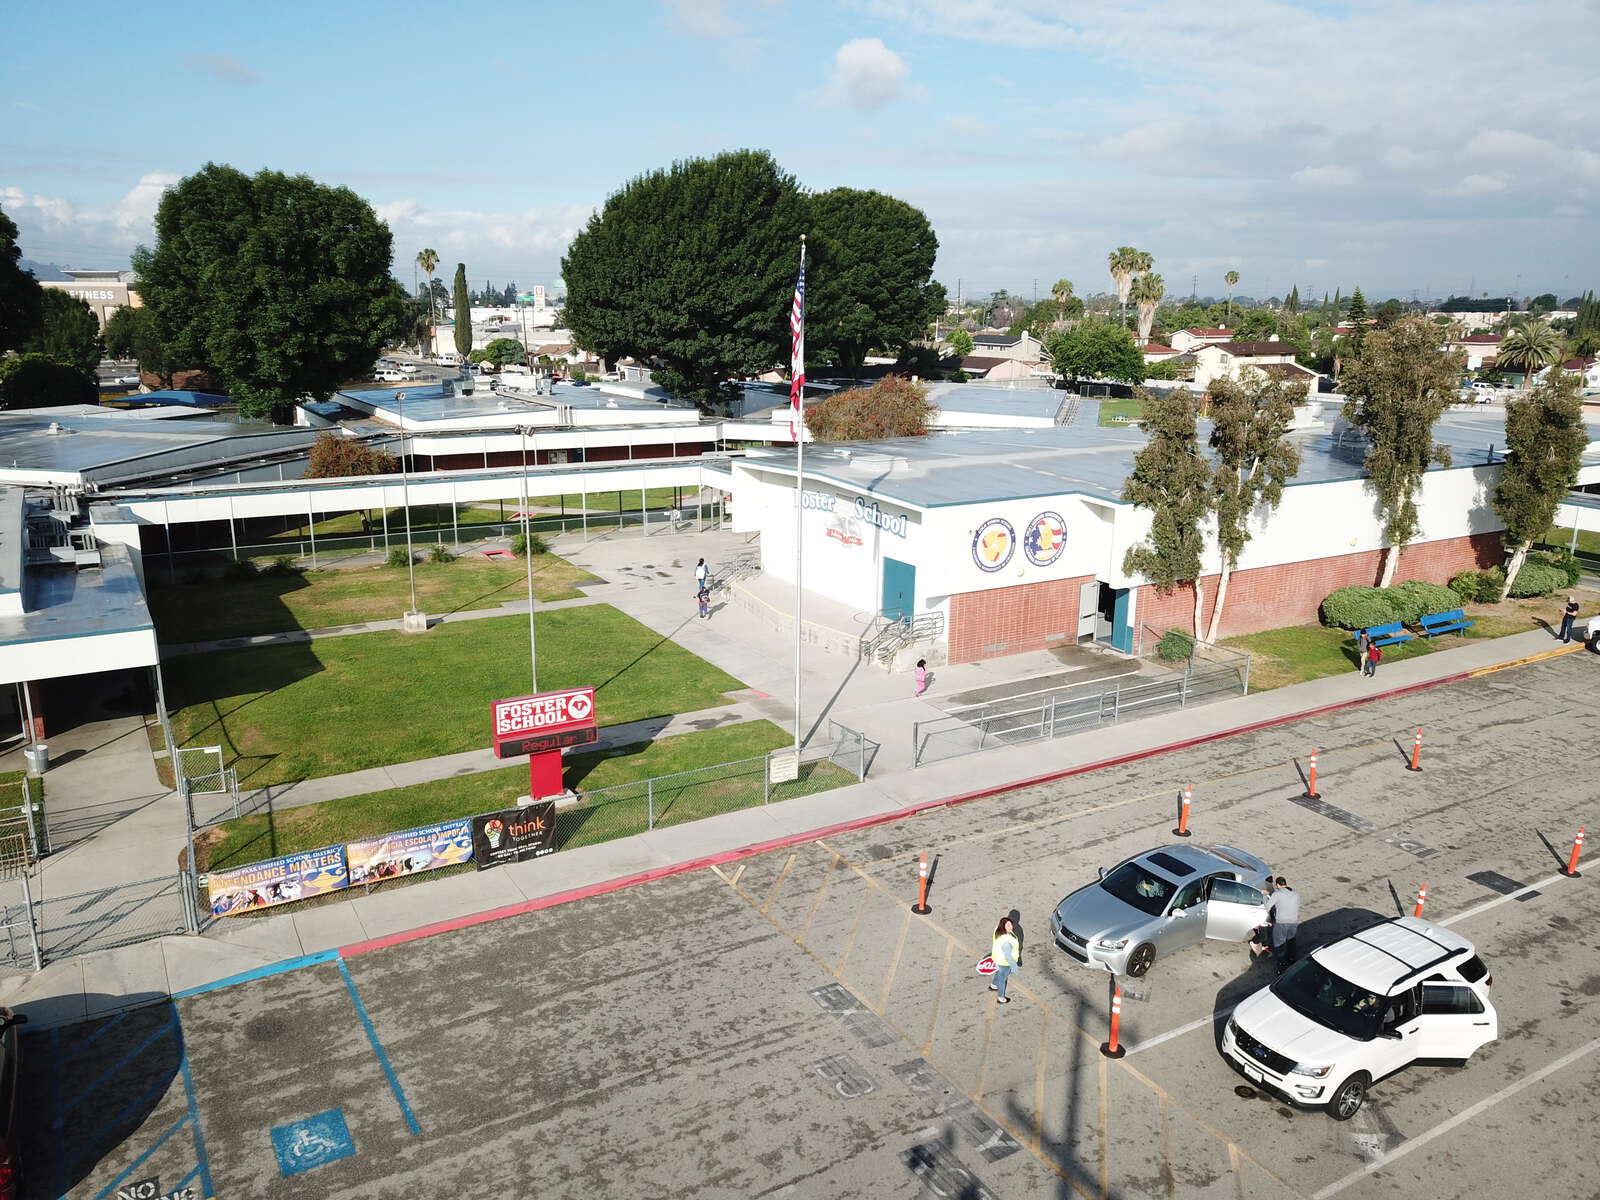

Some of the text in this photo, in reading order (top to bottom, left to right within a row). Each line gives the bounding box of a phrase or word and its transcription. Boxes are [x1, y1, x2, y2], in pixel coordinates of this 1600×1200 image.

[69, 290, 114, 300] FITNESS
[855, 496, 908, 539] School
[500, 697, 567, 720] FOSTER
[500, 710, 567, 732] SCHOOL
[522, 735, 576, 752] Regular
[508, 816, 546, 837] think
[512, 830, 543, 842] TOGETHER
[286, 854, 312, 864] SCHOOL
[289, 852, 342, 873] MATTERS
